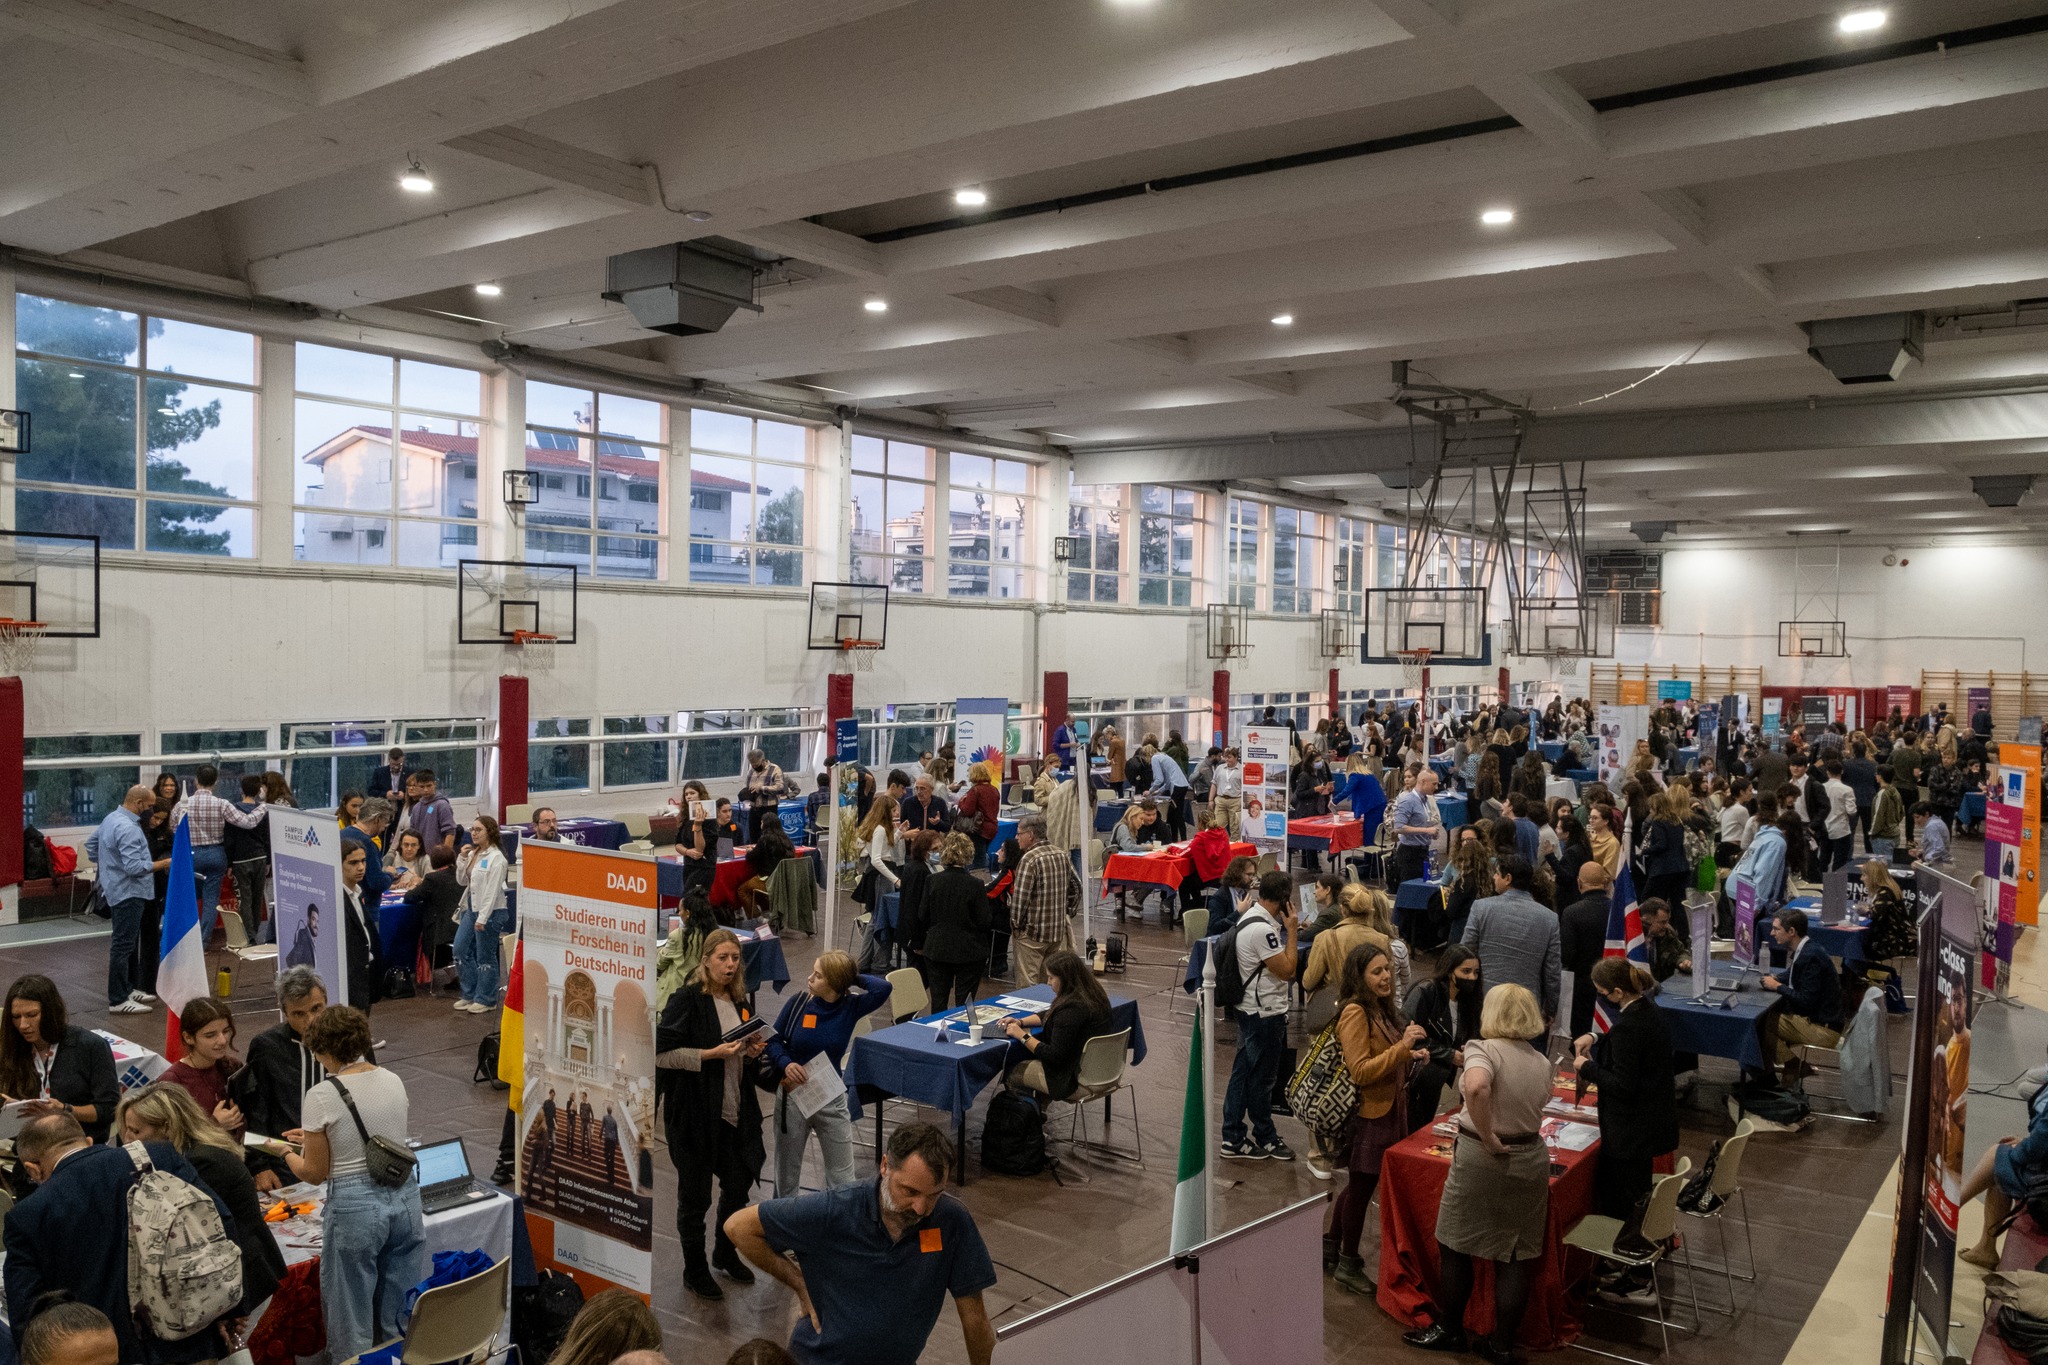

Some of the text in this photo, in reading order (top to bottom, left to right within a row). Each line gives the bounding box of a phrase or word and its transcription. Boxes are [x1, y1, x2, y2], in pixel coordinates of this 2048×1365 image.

[781, 812, 802, 820] GEORGE
[284, 825, 303, 835] CAMPUS
[284, 832, 303, 842] FRANCE
[279, 868, 296, 880] Studying
[607, 872, 647, 894] DAAD
[555, 904, 646, 935] Studieren und
[571, 929, 645, 958] Forschen in
[1266, 933, 1279, 949] 6
[565, 950, 645, 981] Deutschland
[1240, 1143, 1253, 1155] N
[558, 1177, 639, 1209] DAAD Informationszentrum Athen
[557, 1248, 579, 1262] DAAD
